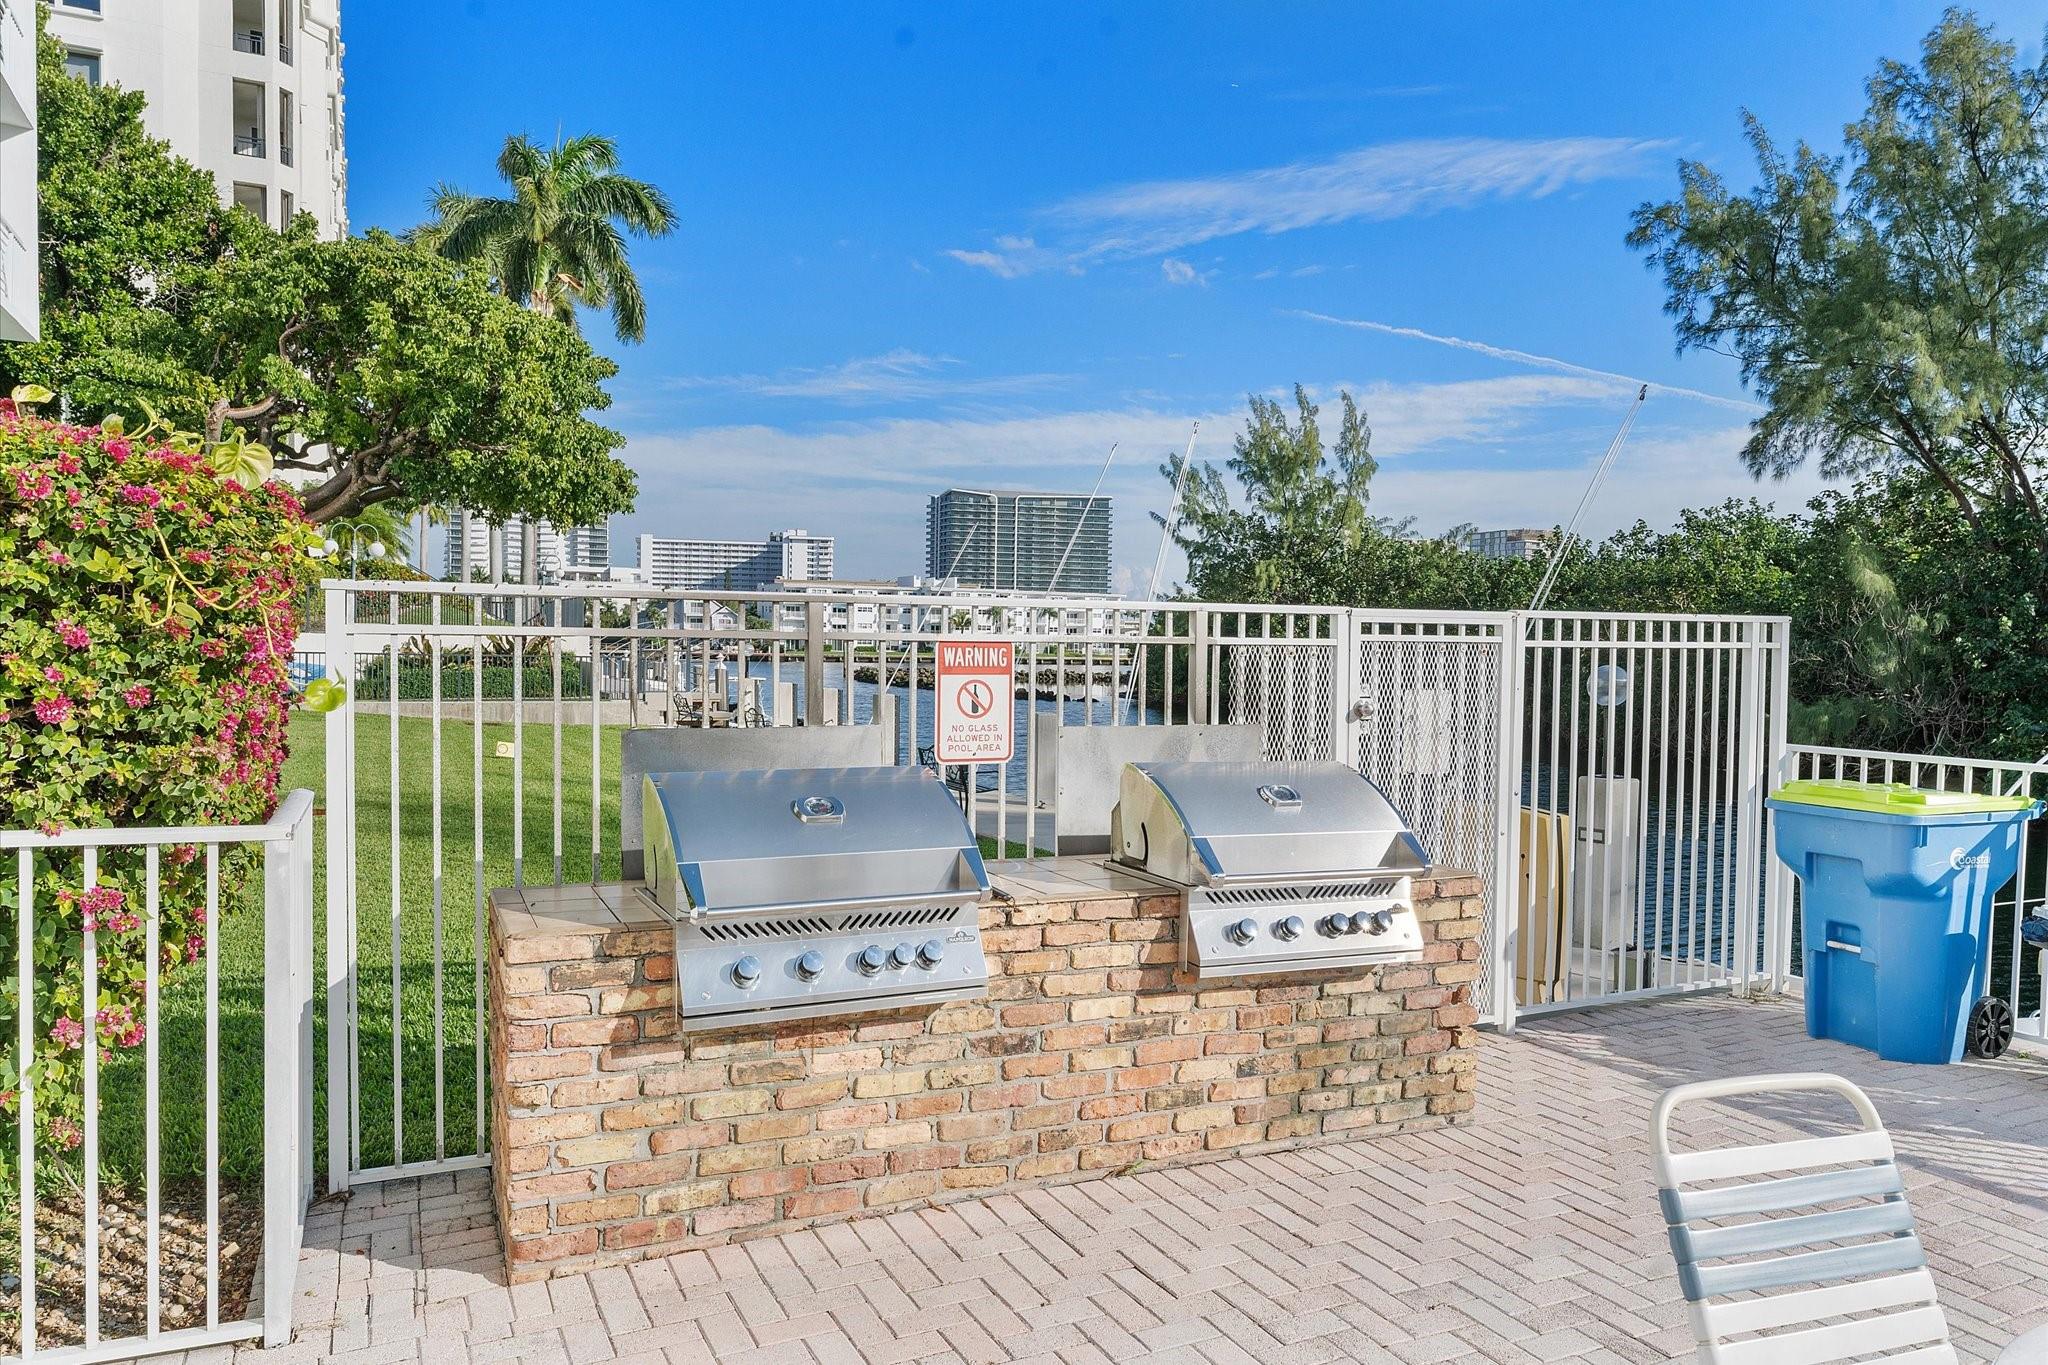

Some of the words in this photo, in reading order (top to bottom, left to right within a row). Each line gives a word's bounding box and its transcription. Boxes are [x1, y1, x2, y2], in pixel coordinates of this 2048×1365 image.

[943, 647, 1008, 667] WARNING
[951, 724, 965, 732] NO
[968, 724, 999, 732] GLASS
[946, 734, 990, 743] ALLOWED
[993, 733, 1003, 741] IN
[947, 744, 973, 752] POOL
[976, 743, 1001, 752] AREA
